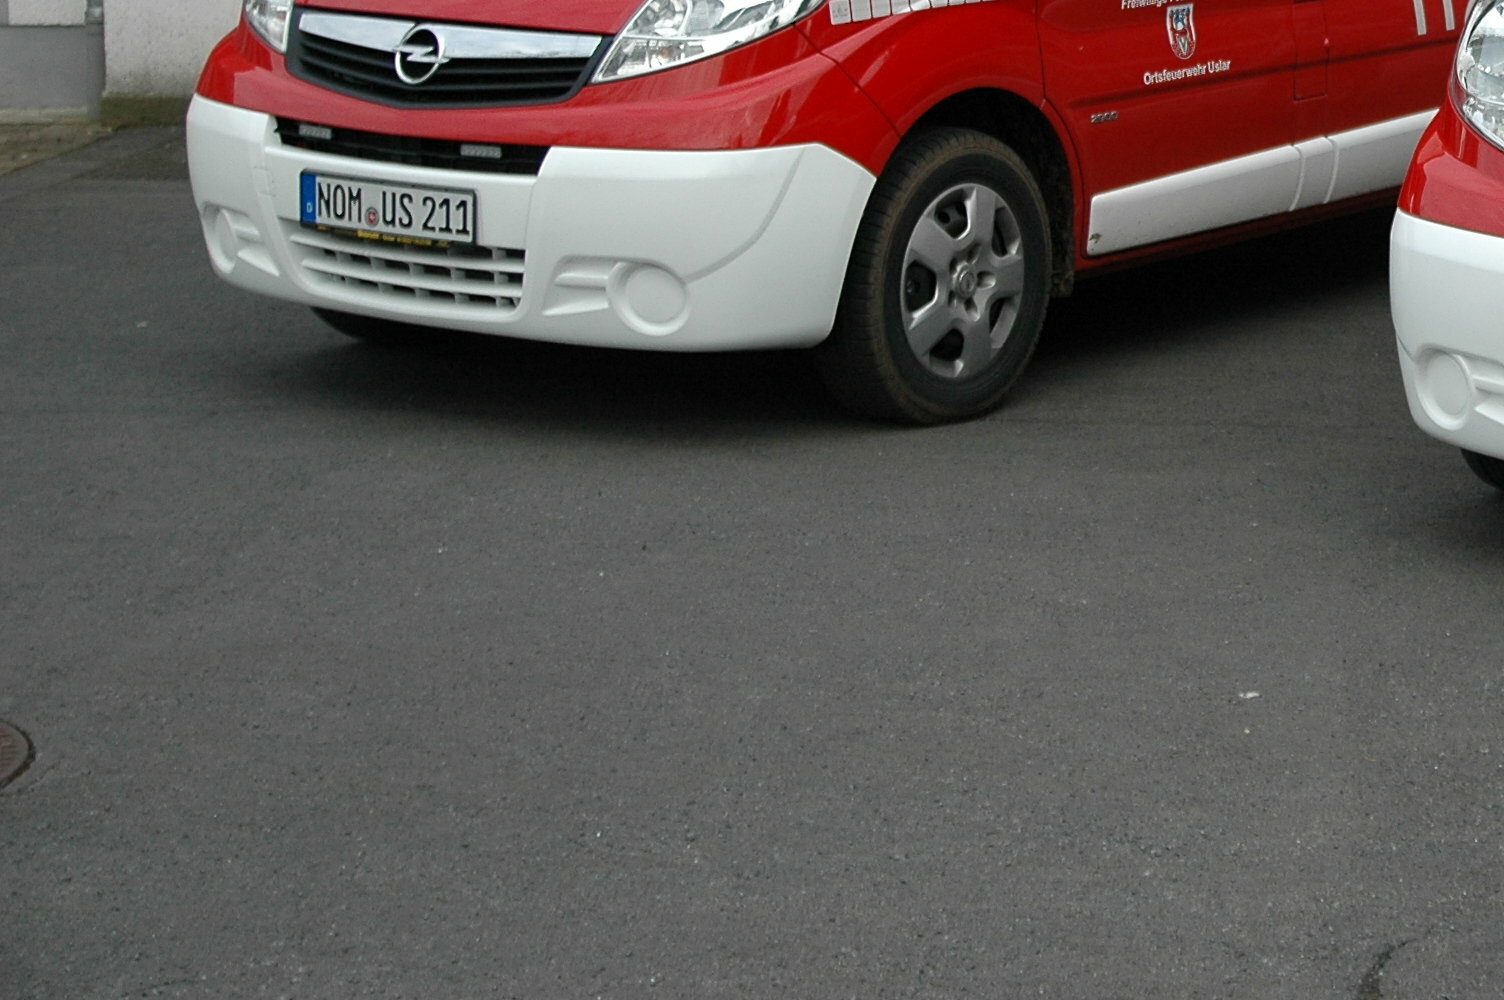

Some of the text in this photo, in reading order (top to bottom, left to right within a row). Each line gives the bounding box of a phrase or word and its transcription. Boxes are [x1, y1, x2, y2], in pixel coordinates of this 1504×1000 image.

[1143, 59, 1232, 86] Ortsfeuerwehr Uslar
[317, 181, 363, 224] NOM
[381, 190, 414, 229] US
[421, 196, 471, 236] 211
